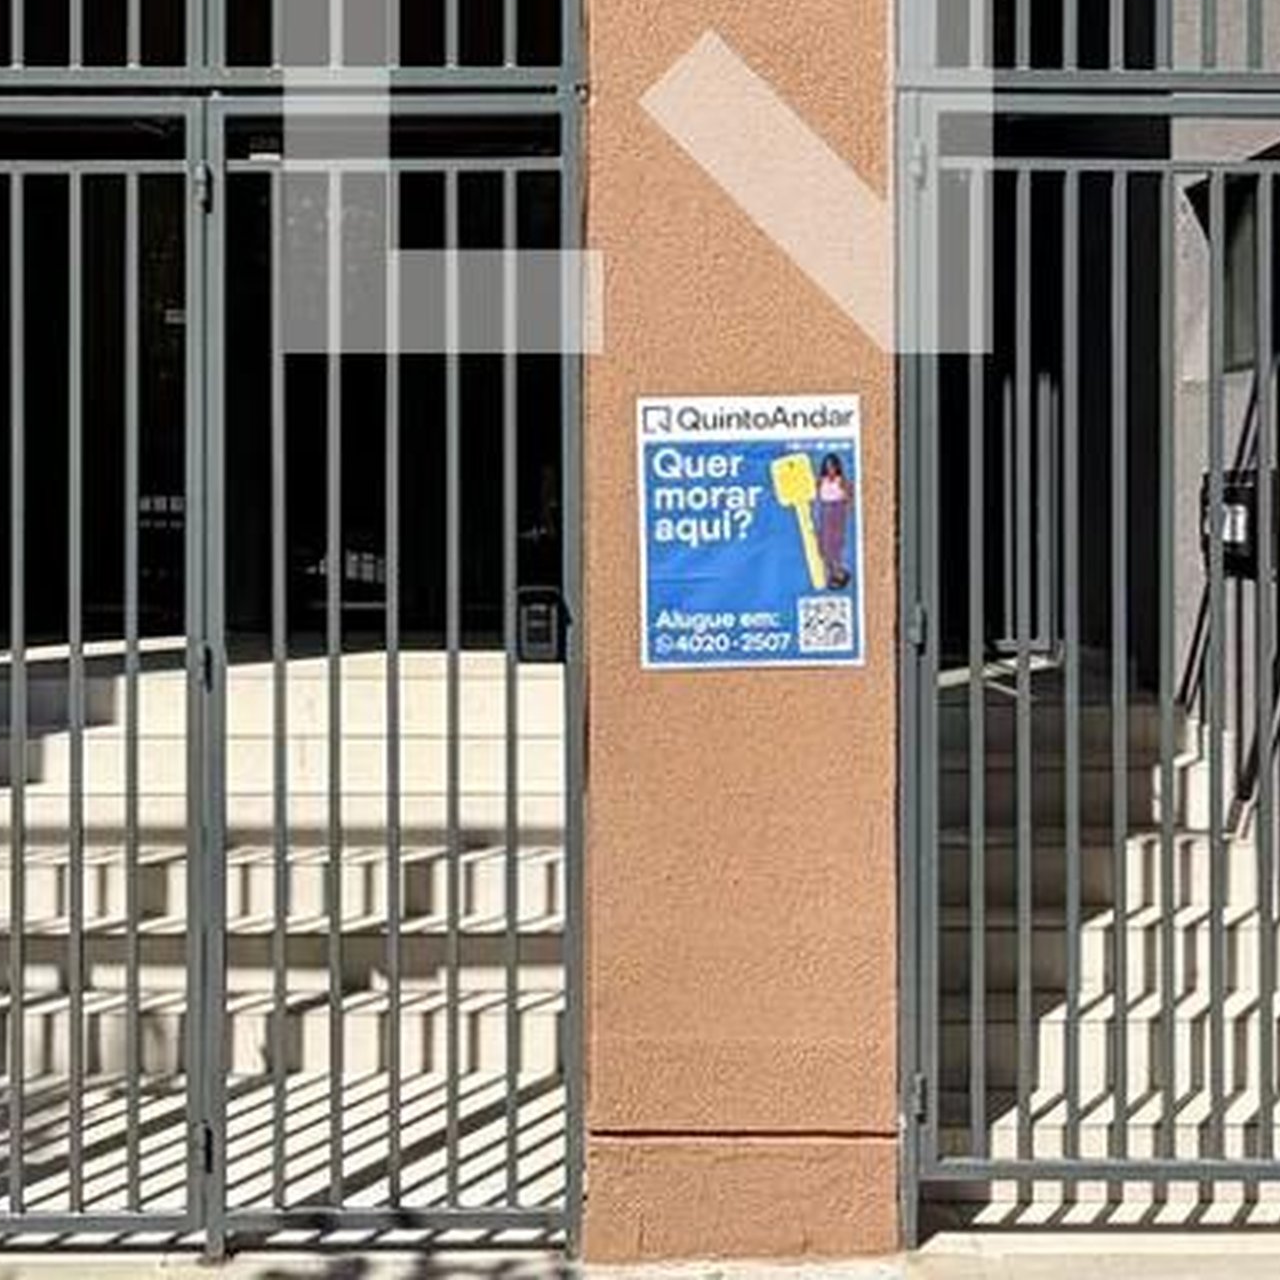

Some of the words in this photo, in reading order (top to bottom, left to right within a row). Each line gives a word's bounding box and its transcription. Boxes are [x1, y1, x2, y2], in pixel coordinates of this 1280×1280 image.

[677, 406, 854, 431] QuintoAndar
[653, 449, 744, 478] Quer
[654, 485, 762, 509] morar
[655, 510, 752, 546] aqui?
[656, 609, 736, 633] Alugue
